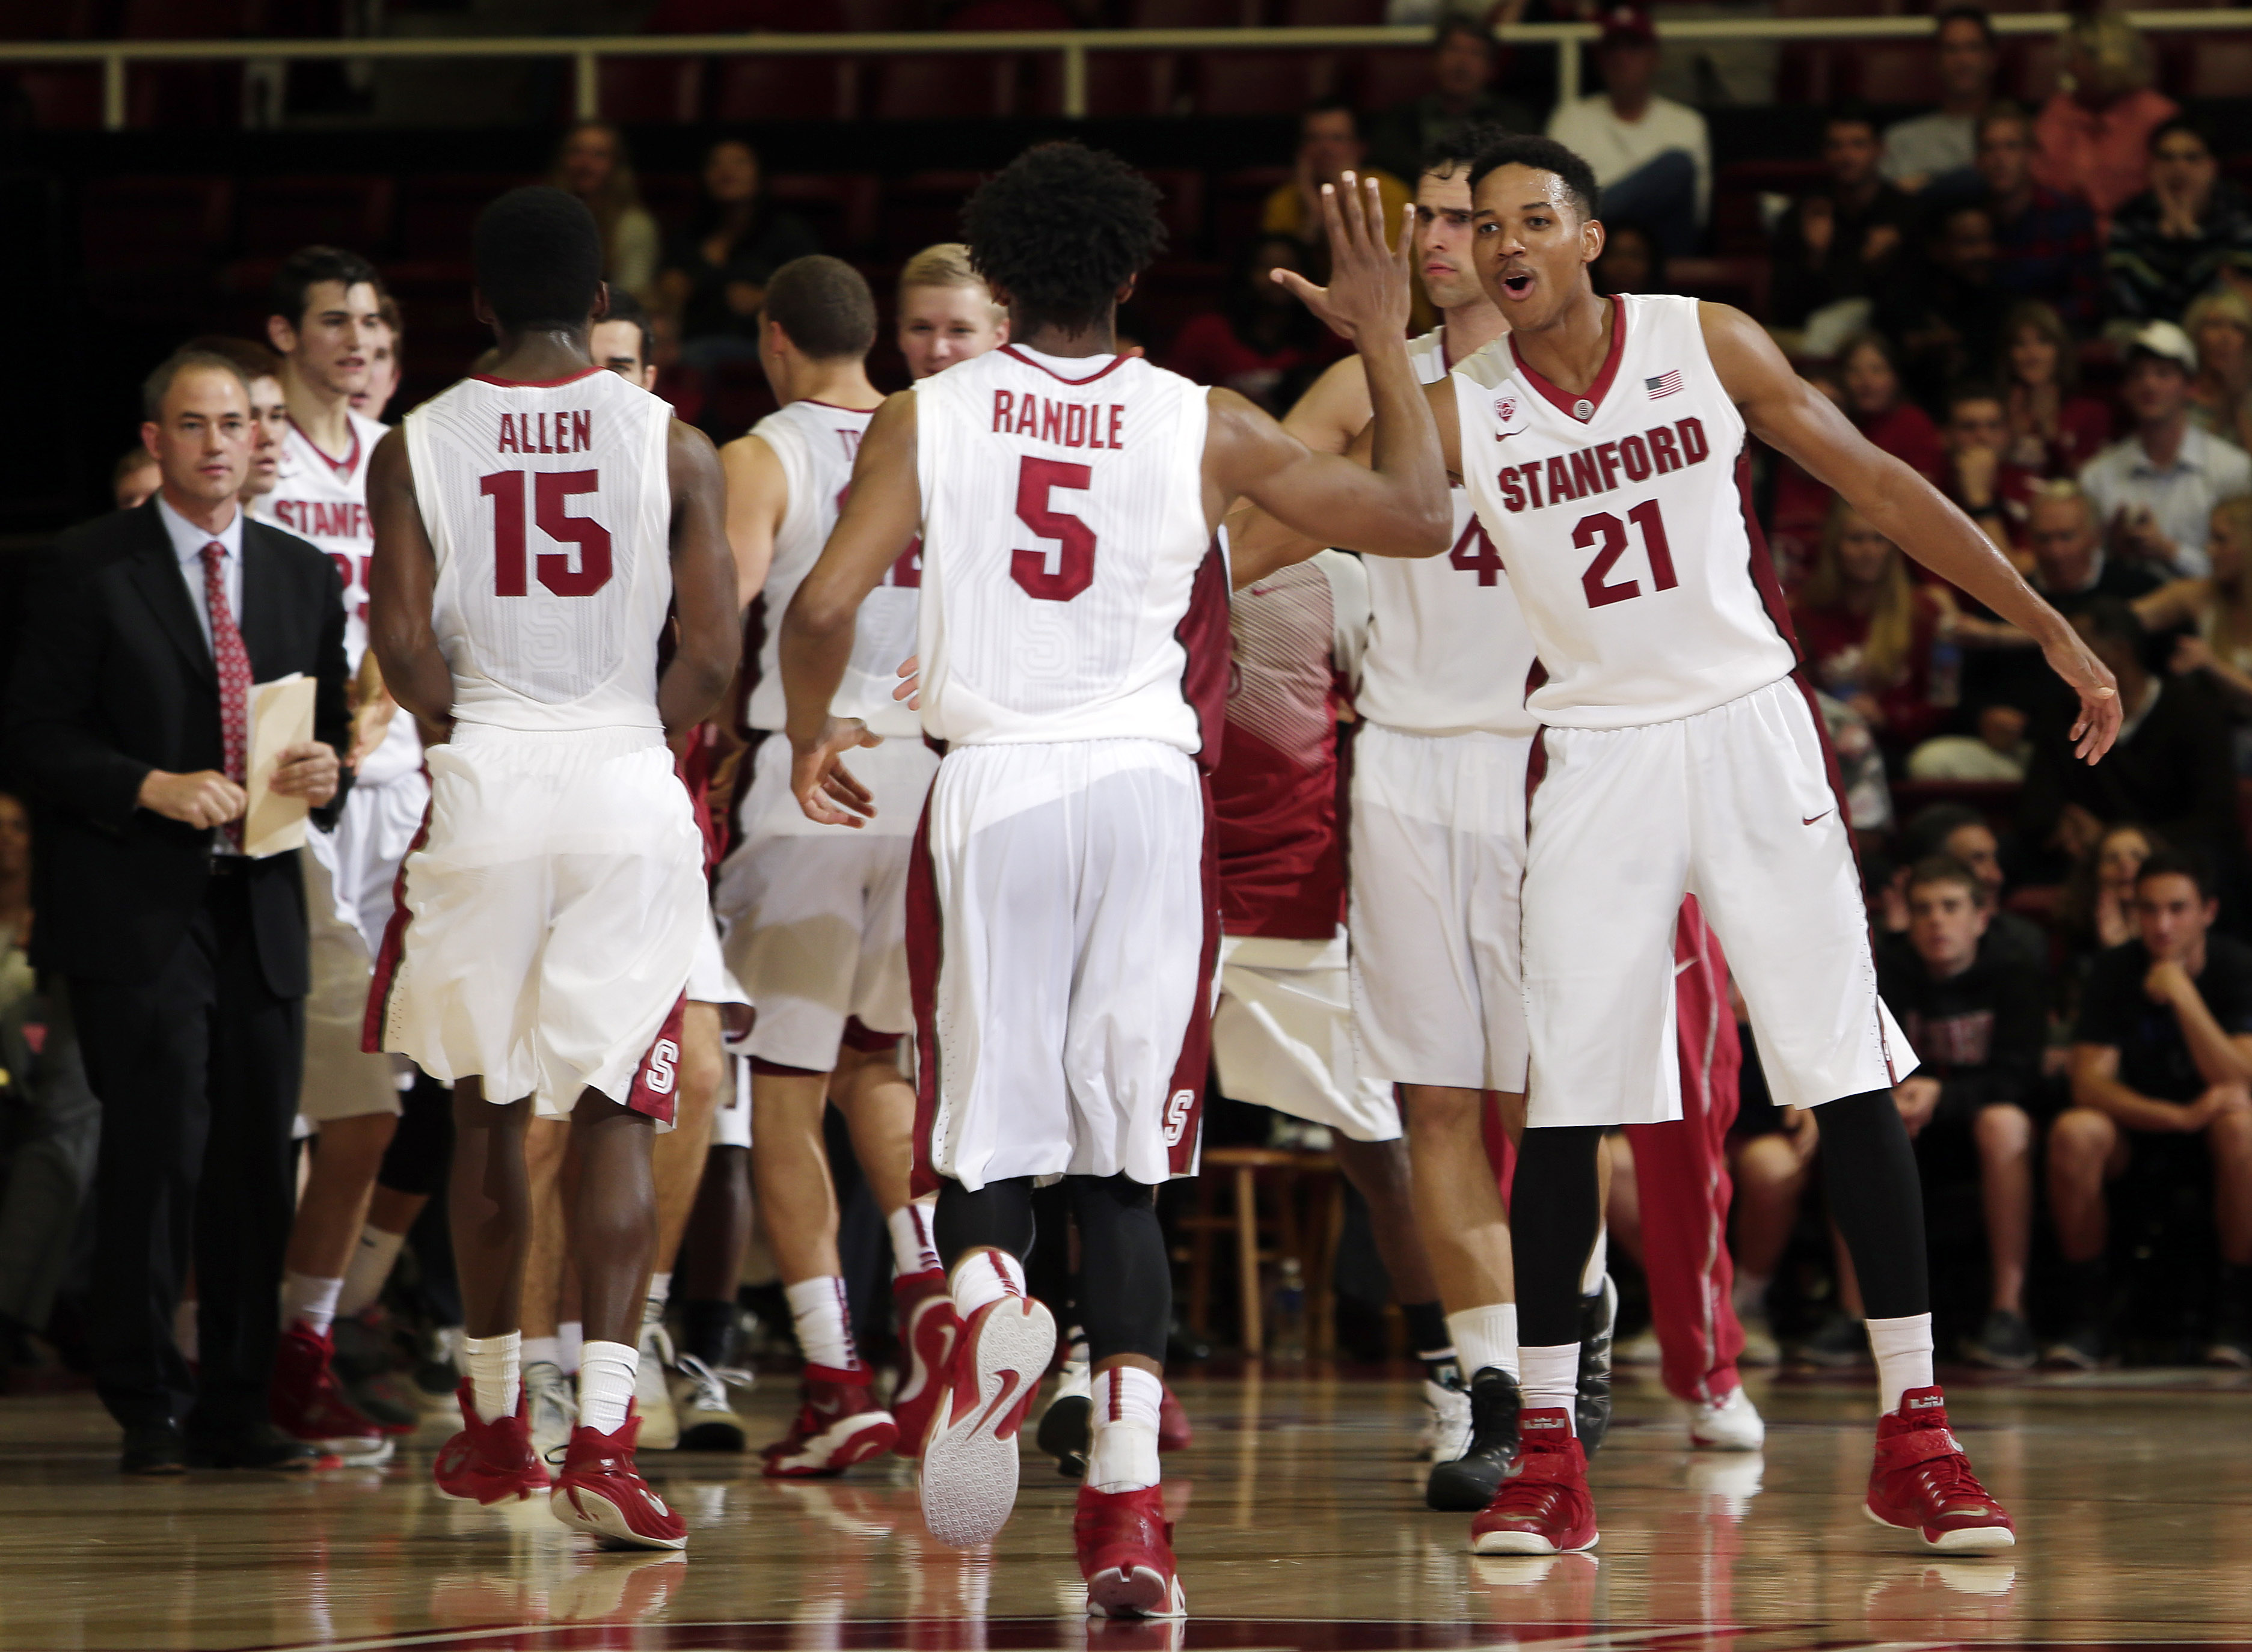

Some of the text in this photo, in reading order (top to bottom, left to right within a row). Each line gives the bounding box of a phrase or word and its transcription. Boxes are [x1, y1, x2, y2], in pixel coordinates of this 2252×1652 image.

[498, 409, 592, 454] ALLEN
[992, 390, 1125, 450] RANDLE
[1497, 416, 1711, 514] STANFORD
[480, 469, 613, 598] 15
[1010, 454, 1097, 602] 5
[1449, 511, 1506, 587] 4
[1571, 498, 1680, 609] 21
[645, 1038, 680, 1095] S
[1163, 1089, 1195, 1148] S
